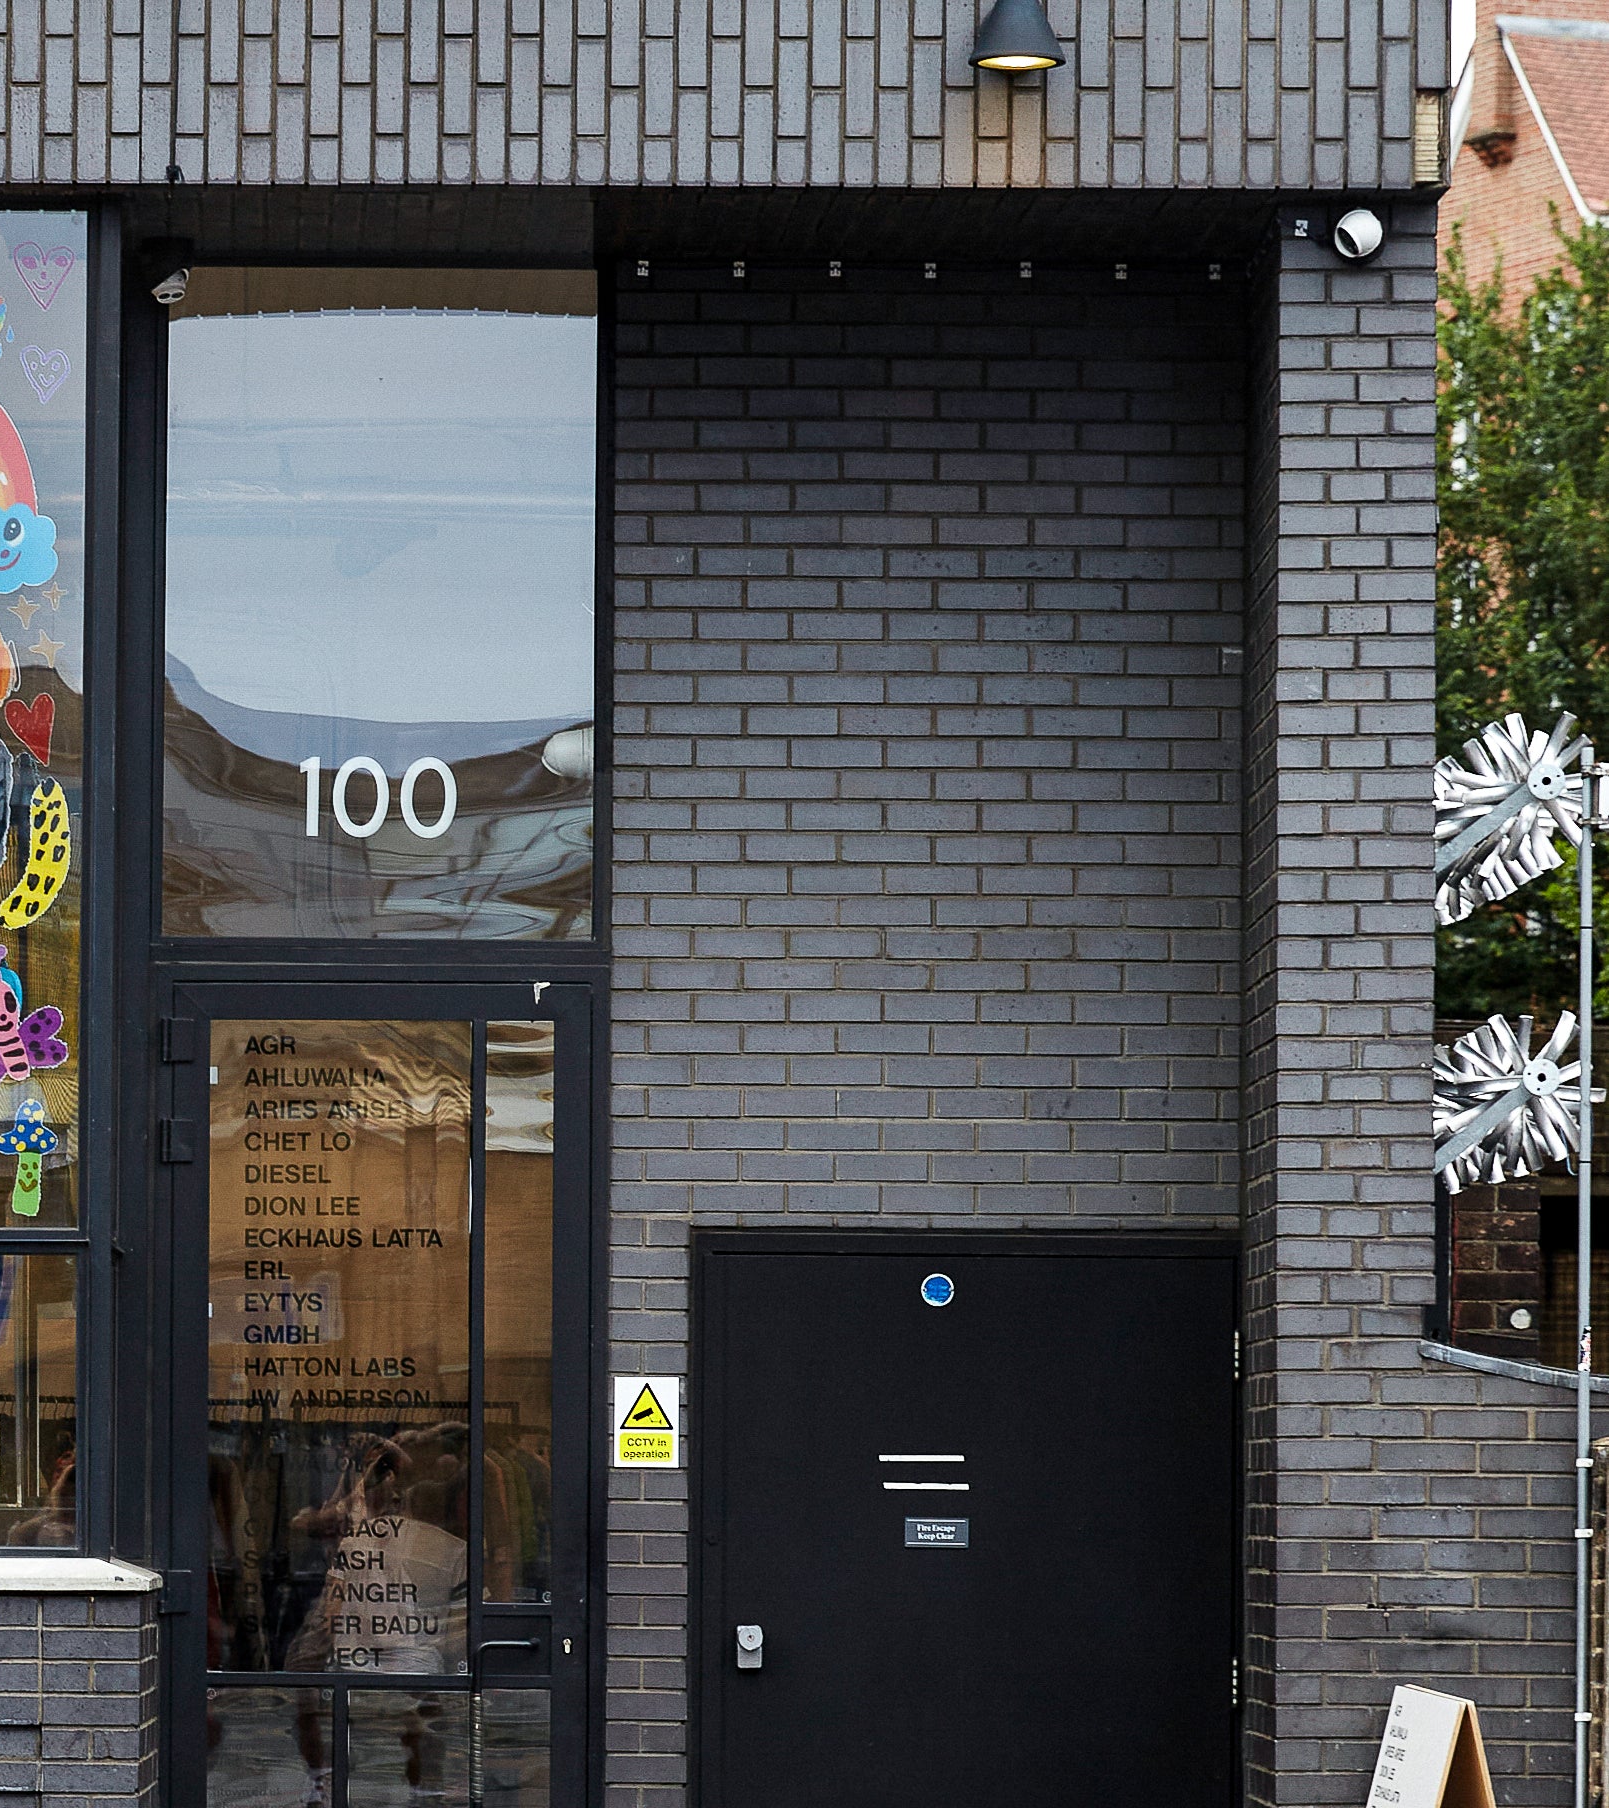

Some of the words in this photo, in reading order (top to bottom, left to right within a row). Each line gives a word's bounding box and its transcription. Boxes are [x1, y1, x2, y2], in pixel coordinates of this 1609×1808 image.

[299, 755, 458, 839] 100
[244, 1035, 296, 1055] AGR
[244, 1067, 387, 1087] AHLUWALIA
[244, 1100, 318, 1120] ARIES
[327, 1100, 402, 1120] ARISE
[244, 1131, 311, 1151] CHET
[321, 1131, 351, 1151] LO
[244, 1164, 331, 1184] DIESEL
[244, 1196, 306, 1216] DION
[316, 1196, 360, 1216] LEE
[244, 1228, 363, 1248] ECKHAUS
[372, 1228, 443, 1248] LATTA
[244, 1260, 291, 1280] ERL
[244, 1293, 323, 1312] EYTYS
[244, 1325, 320, 1344] GMBH
[244, 1357, 340, 1377] HATTON
[350, 1357, 416, 1377] LABS
[245, 1389, 280, 1409] JW
[290, 1389, 430, 1409] ANDERSON
[627, 1437, 655, 1447] CCTV
[657, 1437, 667, 1446] in
[623, 1450, 670, 1460] operation
[916, 1524, 931, 1532] Fire
[931, 1524, 956, 1533] Escape
[917, 1532, 936, 1541] Keep
[936, 1532, 955, 1540] Clear
[371, 1615, 439, 1635] BADU
